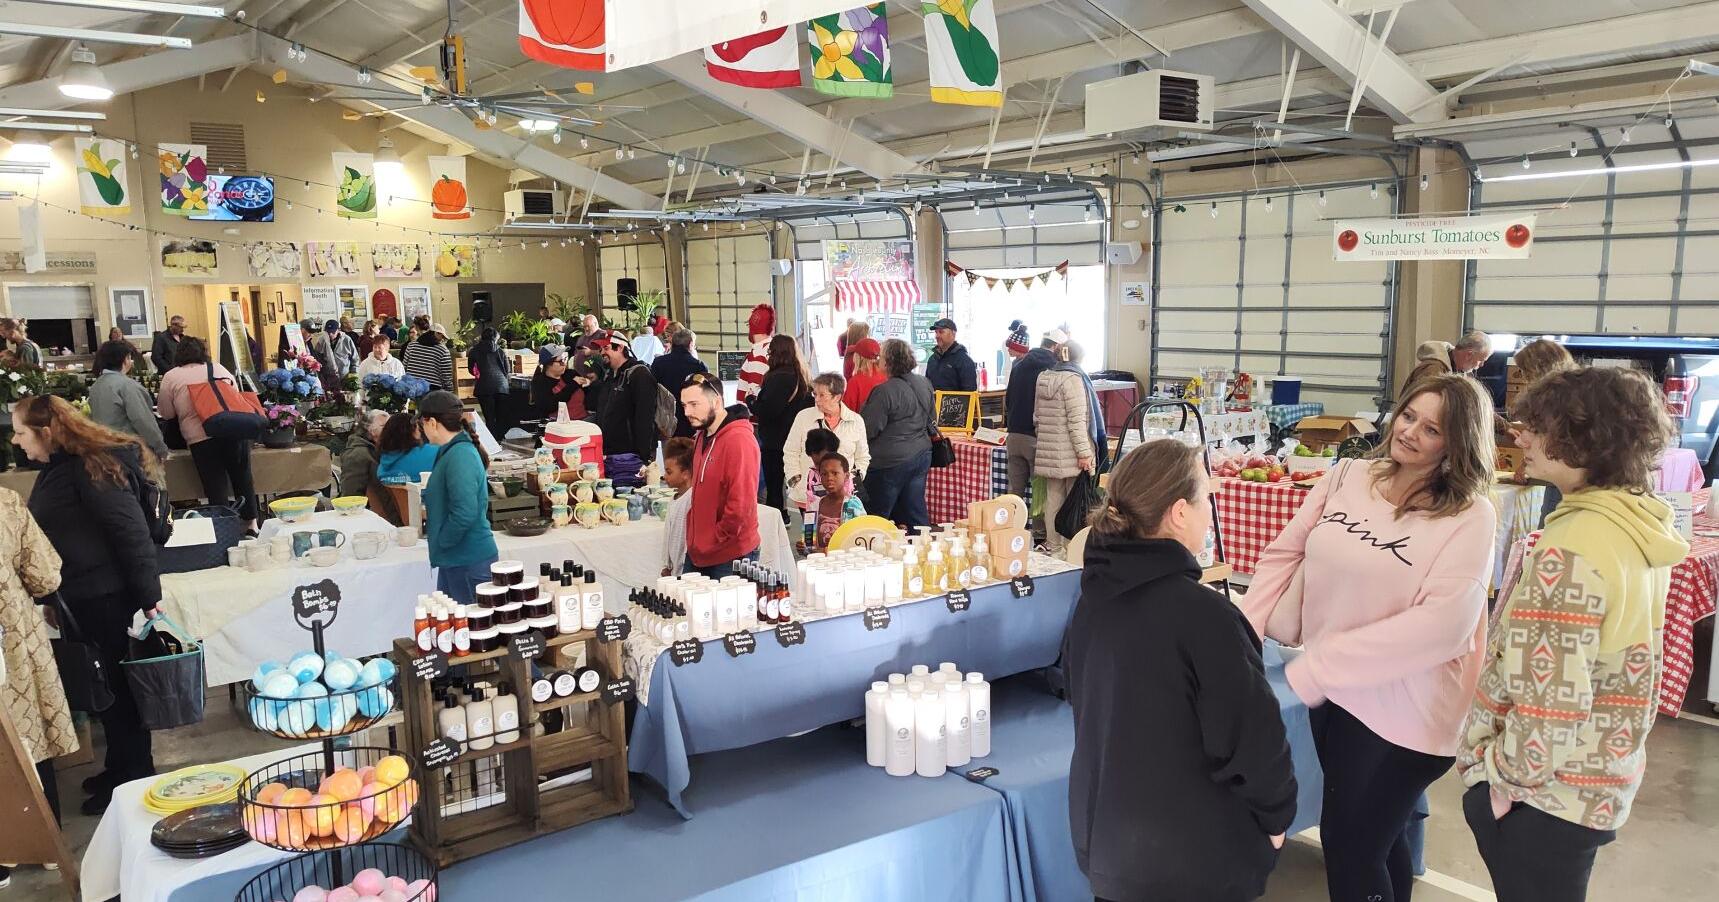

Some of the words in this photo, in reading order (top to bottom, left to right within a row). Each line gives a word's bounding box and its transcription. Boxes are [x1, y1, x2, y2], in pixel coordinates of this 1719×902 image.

[1363, 229, 1425, 244] Sunburst
[1432, 228, 1500, 242] Tomatoes
[1316, 511, 1413, 567] pink
[301, 589, 322, 600] Bath
[303, 597, 329, 609] Bombs
